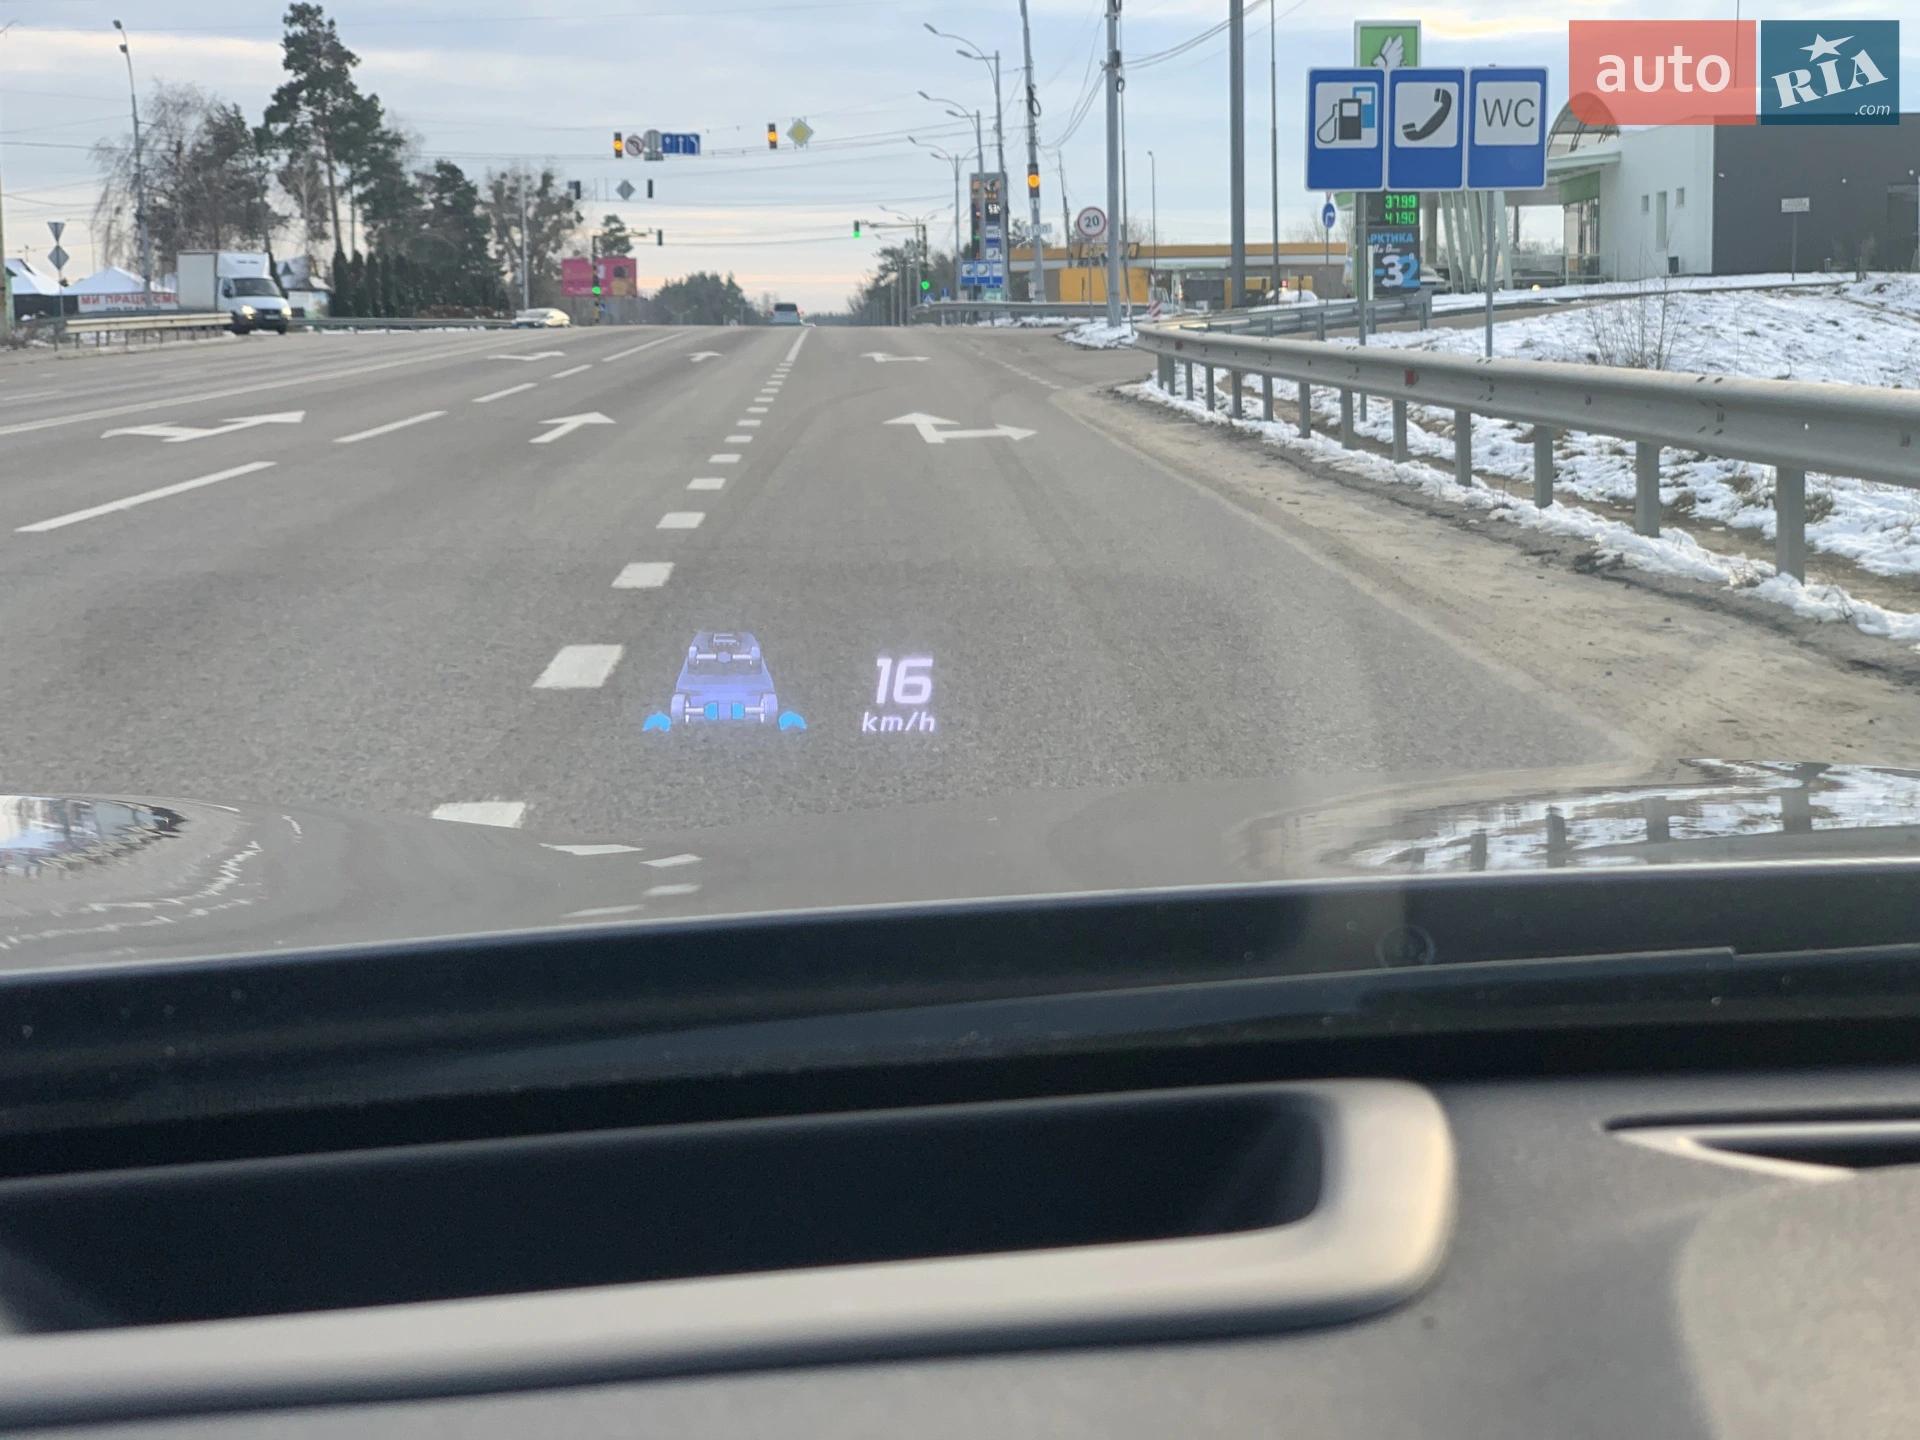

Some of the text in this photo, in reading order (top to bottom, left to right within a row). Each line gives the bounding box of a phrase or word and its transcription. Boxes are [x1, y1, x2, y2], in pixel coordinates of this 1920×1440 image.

[1482, 98, 1535, 128] WC
[1084, 214, 1100, 228] 20
[81, 294, 100, 305] МИ
[876, 657, 933, 704] 16
[861, 711, 936, 732] km/h
